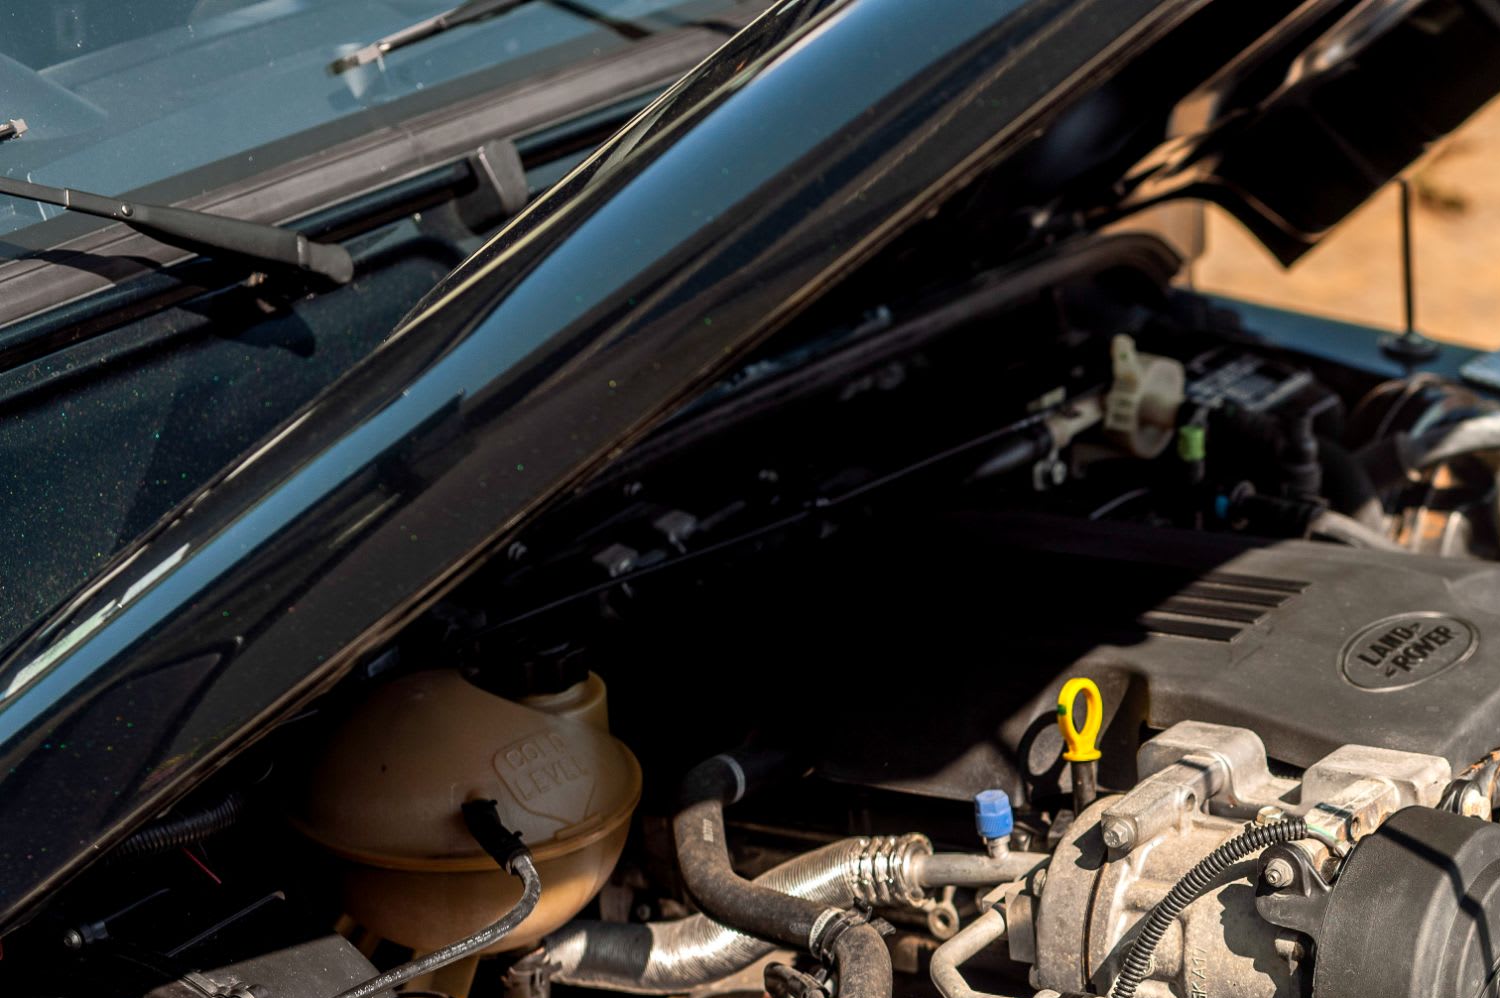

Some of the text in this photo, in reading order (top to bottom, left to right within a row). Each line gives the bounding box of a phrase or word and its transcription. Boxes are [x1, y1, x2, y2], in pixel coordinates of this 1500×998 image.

[1358, 624, 1412, 667] LAND
[1391, 624, 1457, 675] ROVER
[515, 755, 590, 801] LEVEL
